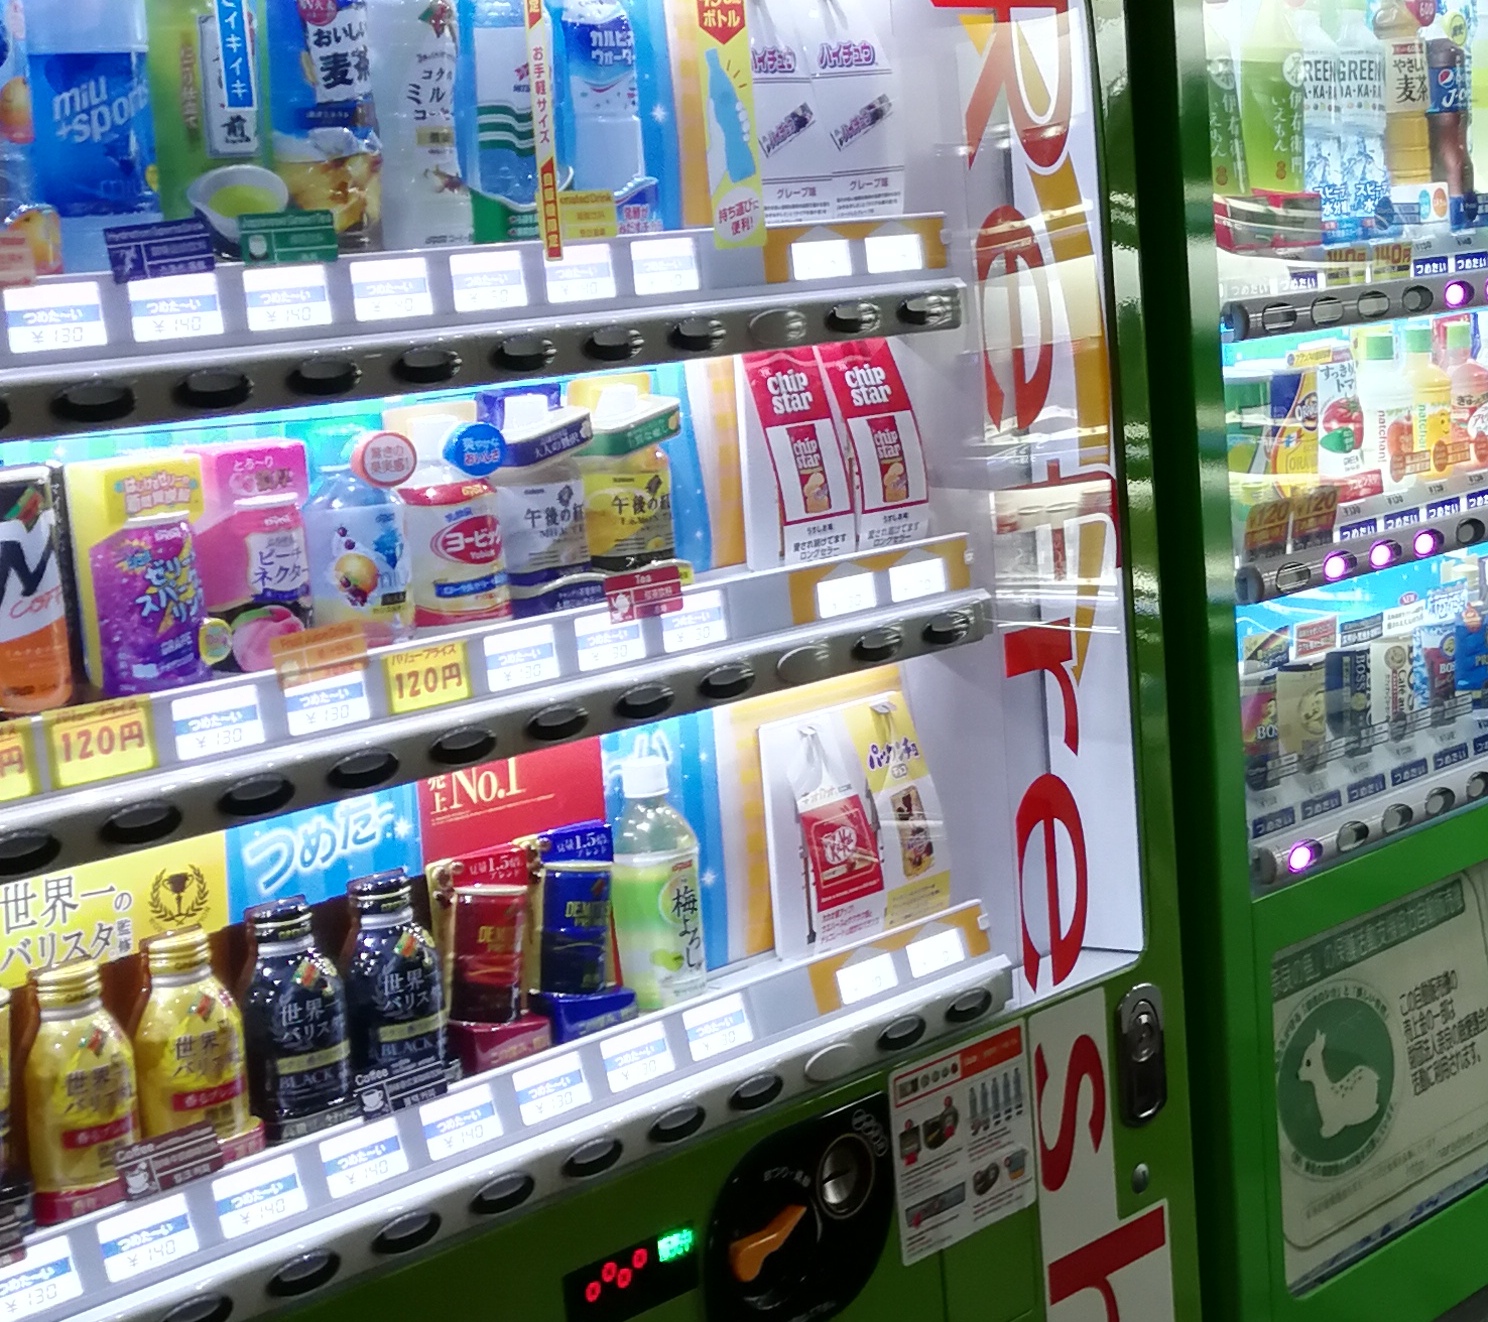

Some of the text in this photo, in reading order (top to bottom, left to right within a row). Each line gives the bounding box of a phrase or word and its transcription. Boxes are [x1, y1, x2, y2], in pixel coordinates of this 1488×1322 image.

[703, 10, 740, 29] ボトル
[818, 39, 877, 69] ハイチュウ
[532, 46, 551, 144] お手軽サイズ
[1395, 74, 1429, 104] 麦茶
[718, 198, 761, 224] 持ち運びに
[767, 364, 809, 395] chip
[844, 363, 886, 388] chip
[771, 388, 813, 415] star
[850, 381, 892, 407] star
[792, 437, 818, 458] chip
[872, 428, 899, 447] chip
[876, 441, 901, 459] star
[795, 452, 820, 470] star
[394, 662, 463, 700] 120円
[61, 721, 146, 764] 120円
[451, 757, 527, 809] No.1
[0, 874, 134, 933] 世界一の
[1, 921, 117, 973] バリスタ
[115, 1141, 156, 1162] Coffee
